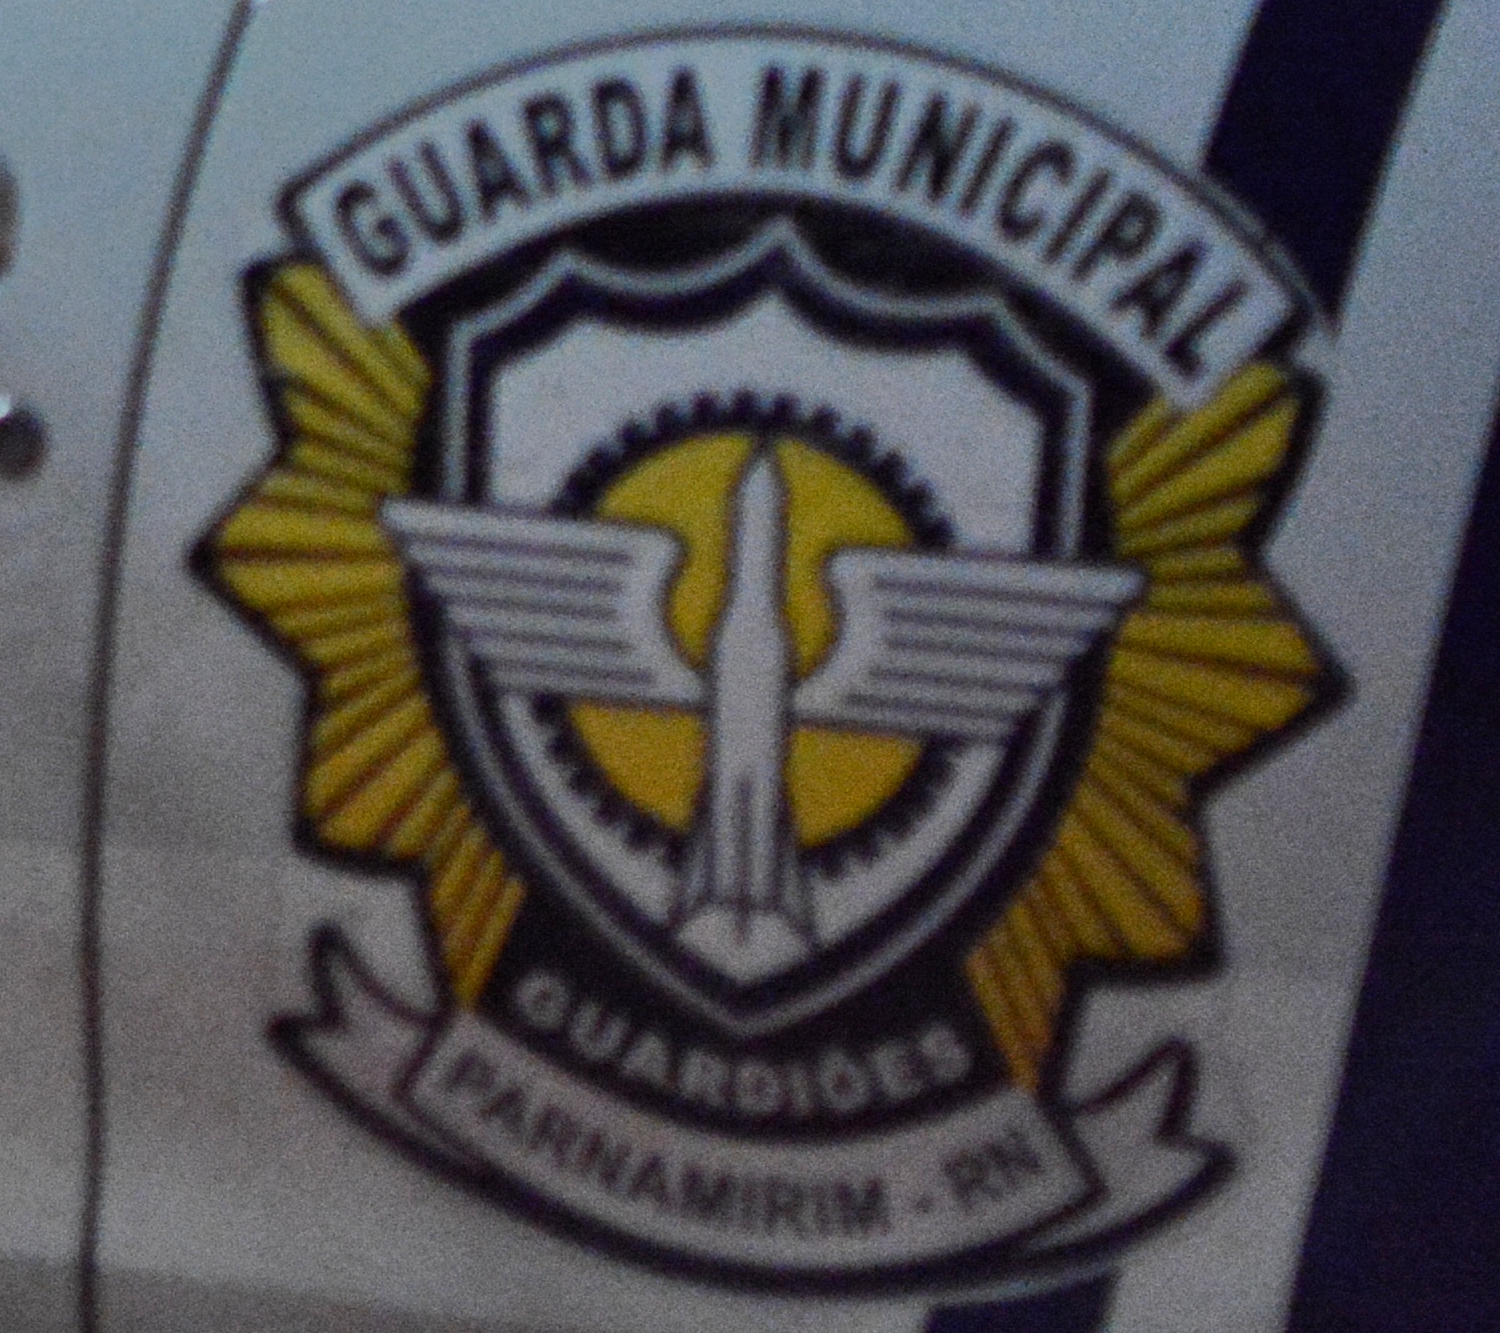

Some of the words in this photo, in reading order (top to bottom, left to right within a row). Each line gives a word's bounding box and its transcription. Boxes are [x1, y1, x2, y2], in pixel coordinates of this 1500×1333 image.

[333, 63, 717, 277] GUARDA
[748, 63, 1251, 380] MUNICIPAL
[442, 1049, 891, 1235] PARNAMIRIM
[941, 1129, 1045, 1213] RN
